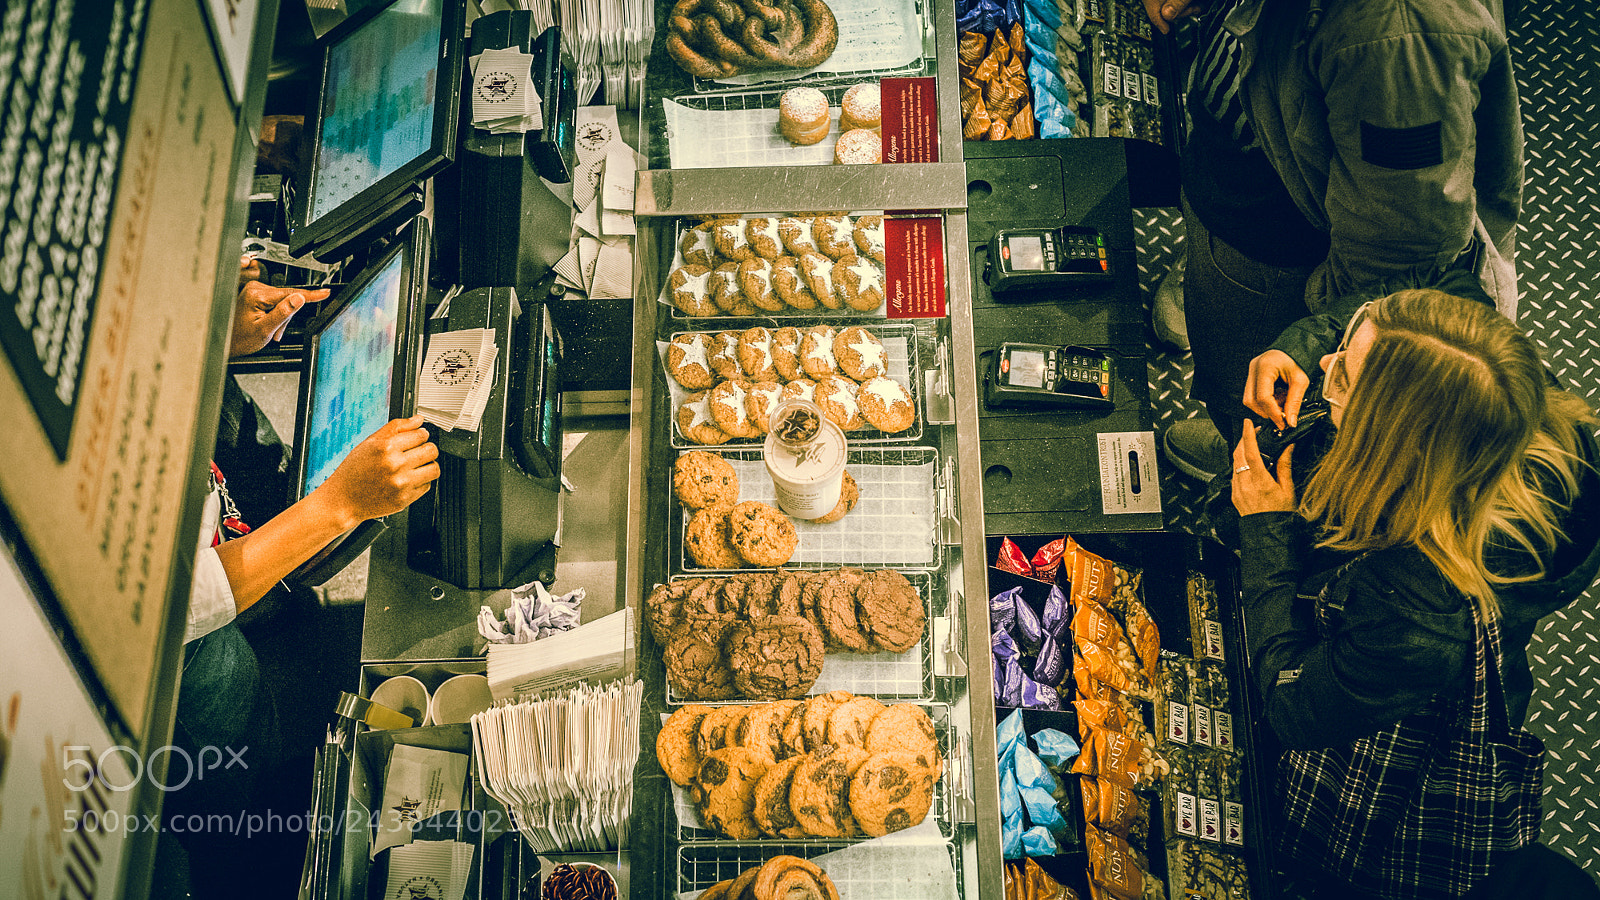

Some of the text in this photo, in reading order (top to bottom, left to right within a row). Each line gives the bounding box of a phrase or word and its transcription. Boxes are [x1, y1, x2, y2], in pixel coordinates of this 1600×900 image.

[1089, 561, 1103, 597] NUT
[1209, 623, 1218, 635] BAR
[1173, 705, 1183, 718] BAR
[1198, 708, 1207, 721] BAR
[1218, 714, 1228, 727] BAR
[1116, 790, 1126, 821] NUT
[1181, 796, 1191, 809] BAR
[1204, 802, 1214, 815] BAR
[1229, 804, 1239, 818] BAR
